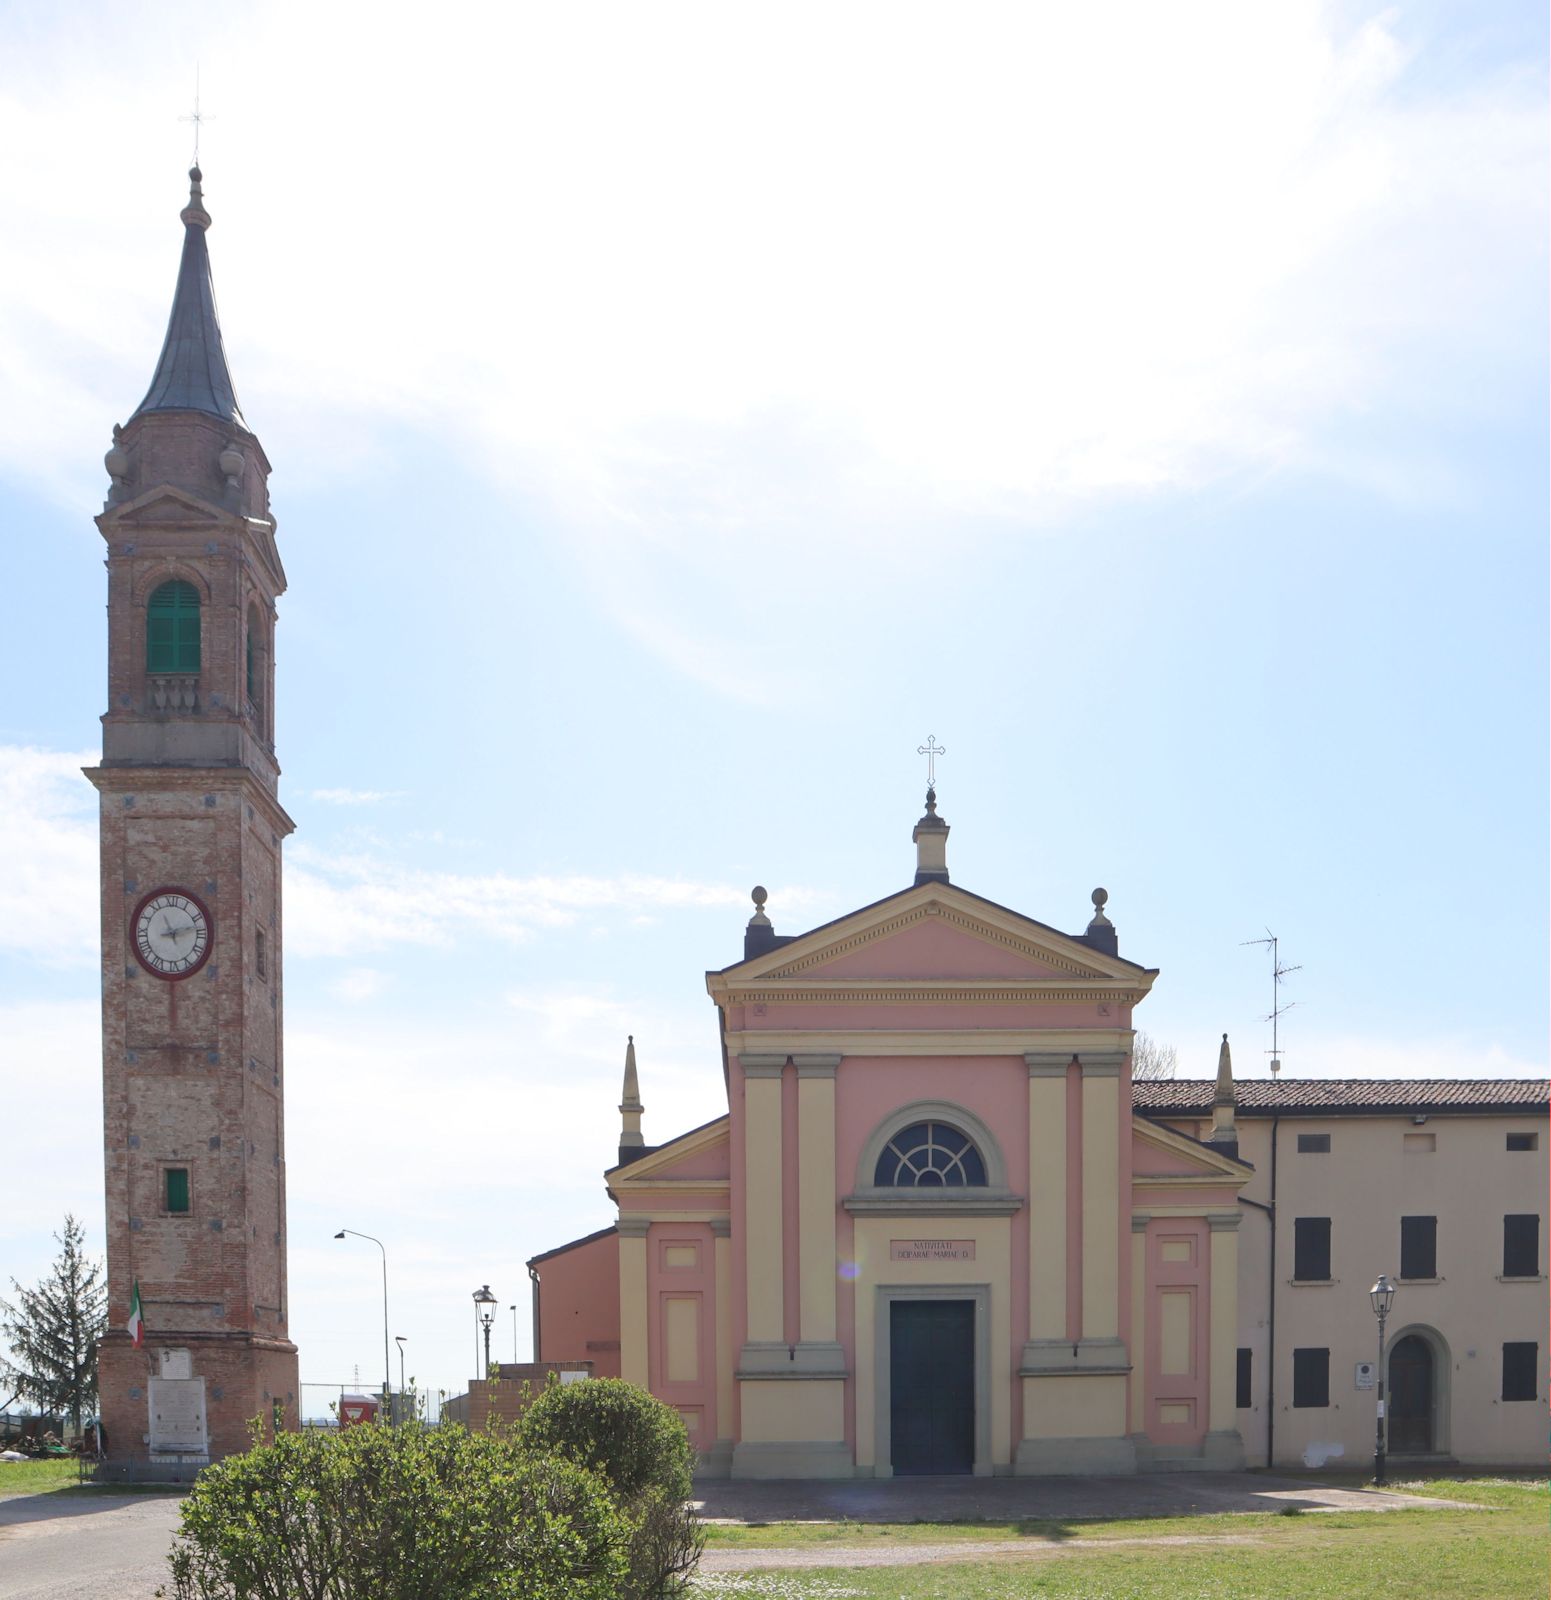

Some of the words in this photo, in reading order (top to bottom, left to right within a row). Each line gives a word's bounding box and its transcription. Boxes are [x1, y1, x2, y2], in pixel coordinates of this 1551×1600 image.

[149, 900, 161, 911] XI
[166, 896, 179, 907] XII
[183, 900, 189, 911] I
[192, 913, 202, 923] II
[138, 928, 148, 938] IX
[196, 928, 207, 939] III
[169, 961, 180, 972] VI
[184, 957, 193, 969] V
[914, 1242, 952, 1250] NATIVITATI
